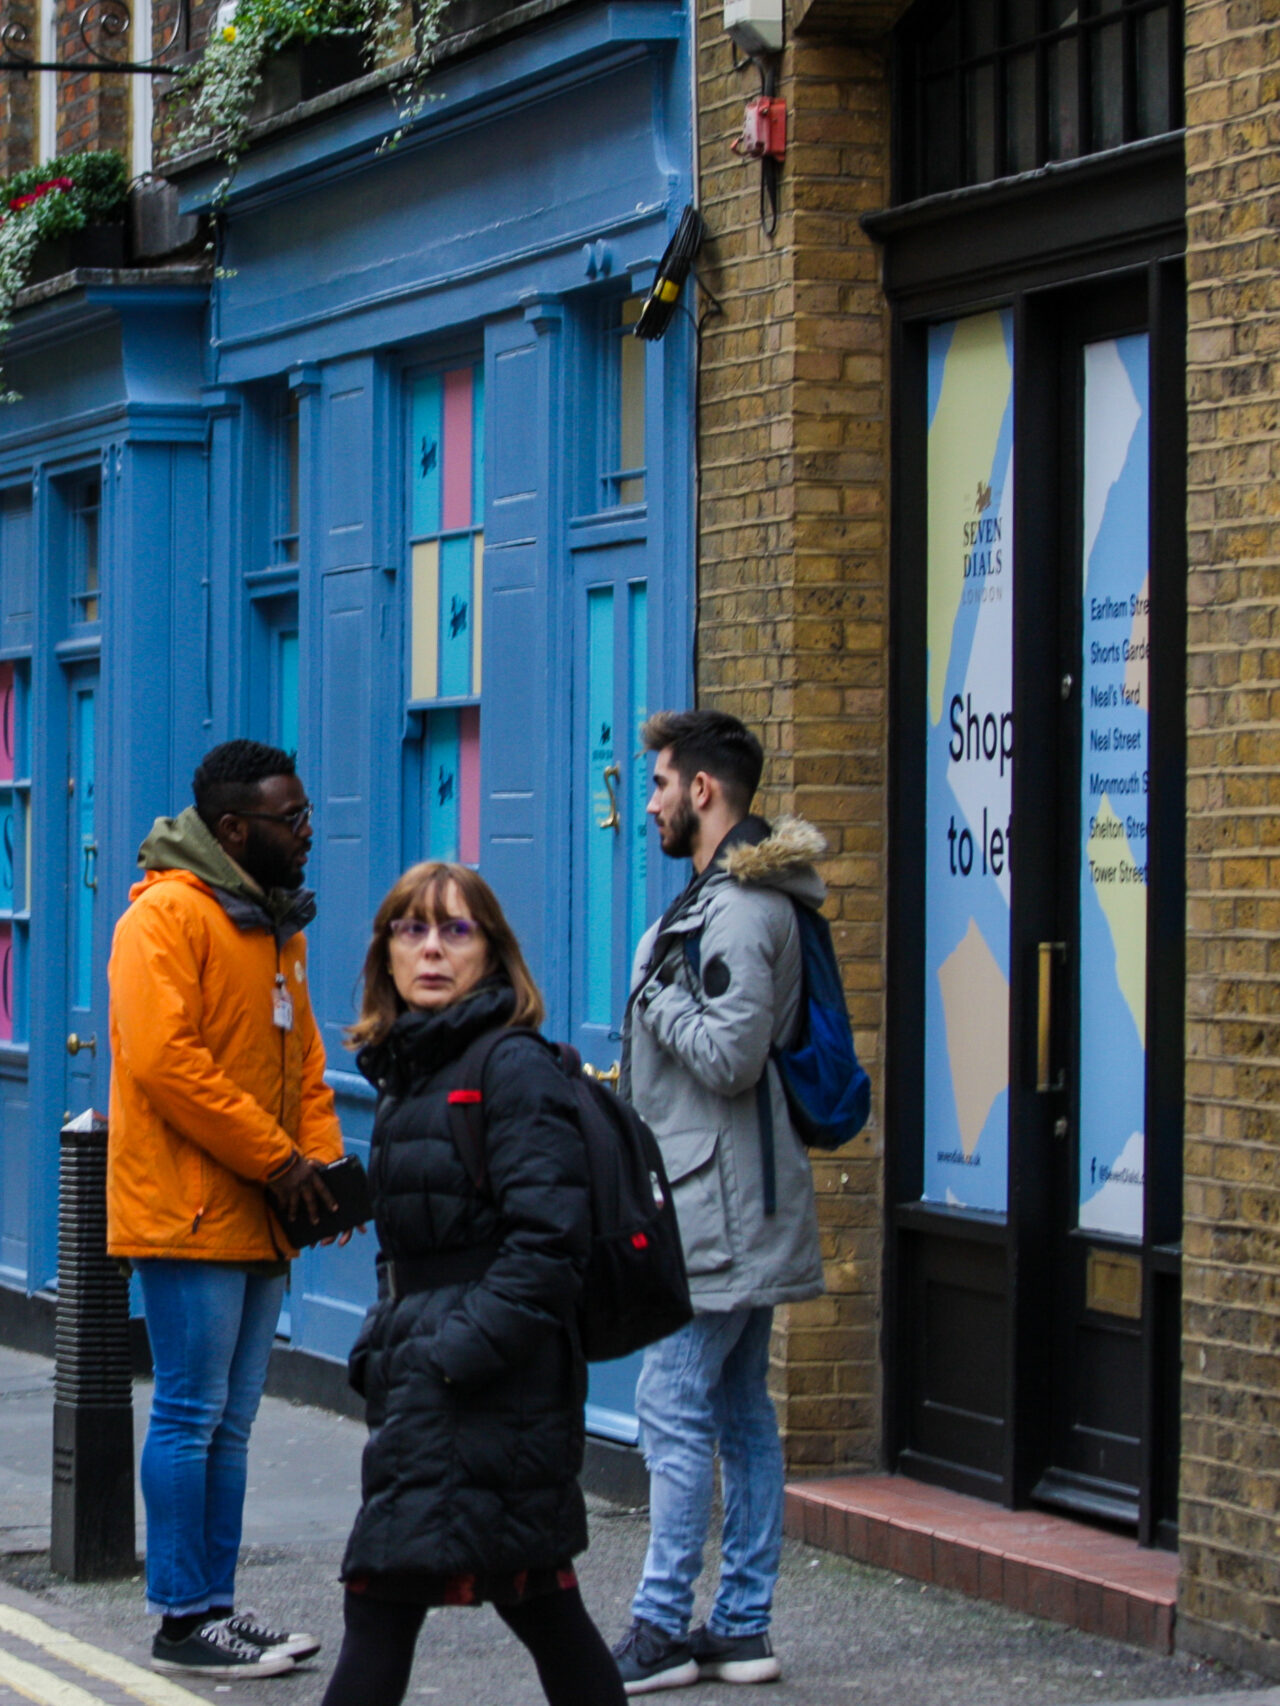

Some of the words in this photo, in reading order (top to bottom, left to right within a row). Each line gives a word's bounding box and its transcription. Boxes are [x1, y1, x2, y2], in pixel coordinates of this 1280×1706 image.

[963, 517, 1002, 547] SEVEN
[963, 549, 1002, 578] DIALS
[962, 585, 1003, 607] LONDON
[1091, 597, 1128, 620] Earlham
[1091, 640, 1120, 664] Shorts
[1091, 683, 1118, 707] Neal's
[1120, 682, 1140, 706] Yard
[1091, 729, 1111, 751] Neal
[1113, 727, 1141, 751] Street
[1090, 771, 1140, 795] Monmouth
[1090, 816, 1124, 840] Shelton
[948, 815, 974, 877] to
[1090, 860, 1117, 882] Tower
